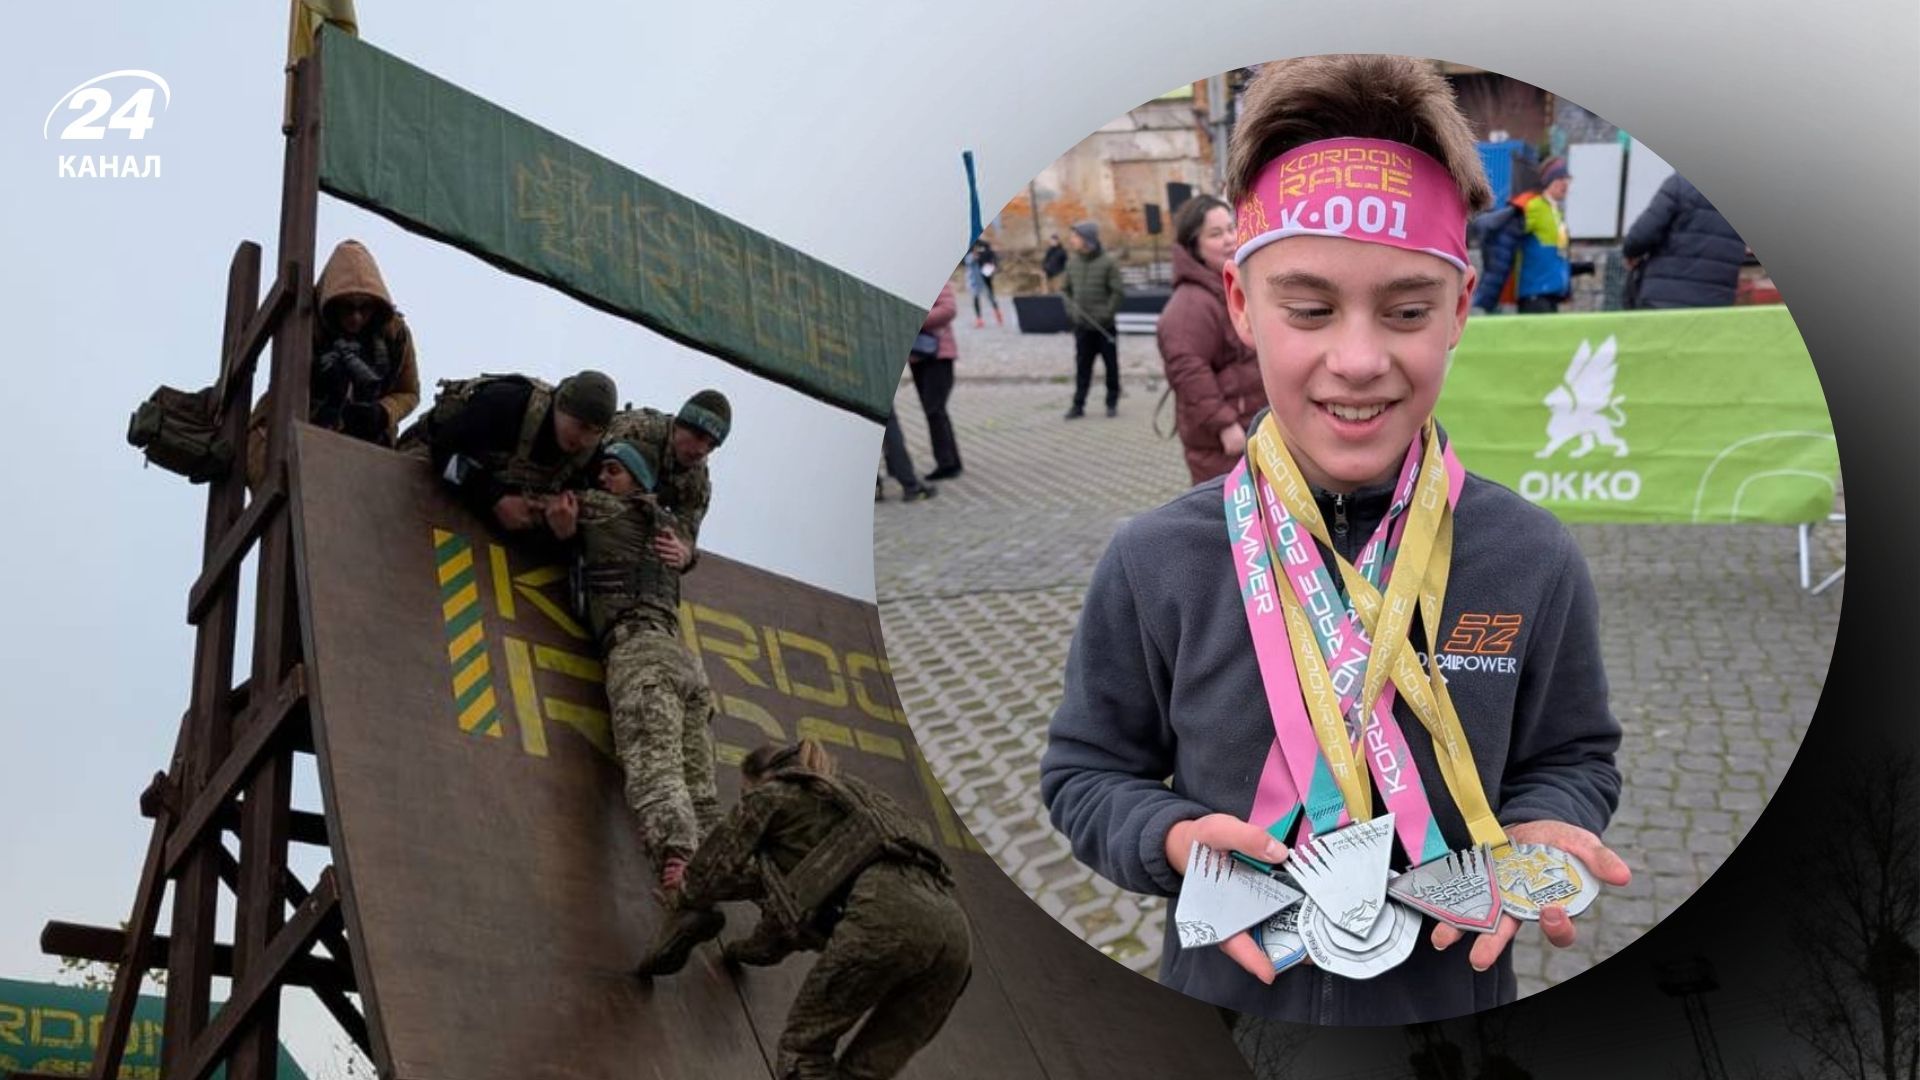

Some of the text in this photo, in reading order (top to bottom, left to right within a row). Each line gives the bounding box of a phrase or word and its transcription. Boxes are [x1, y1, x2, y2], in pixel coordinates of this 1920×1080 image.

[1279, 147, 1414, 178] KORDON
[1279, 164, 1413, 205] RACE
[1518, 469, 1642, 502] OKKO
[1233, 484, 1274, 616] SUMMER
[1298, 569, 1345, 661] RACE
[1430, 877, 1485, 904] RACE
